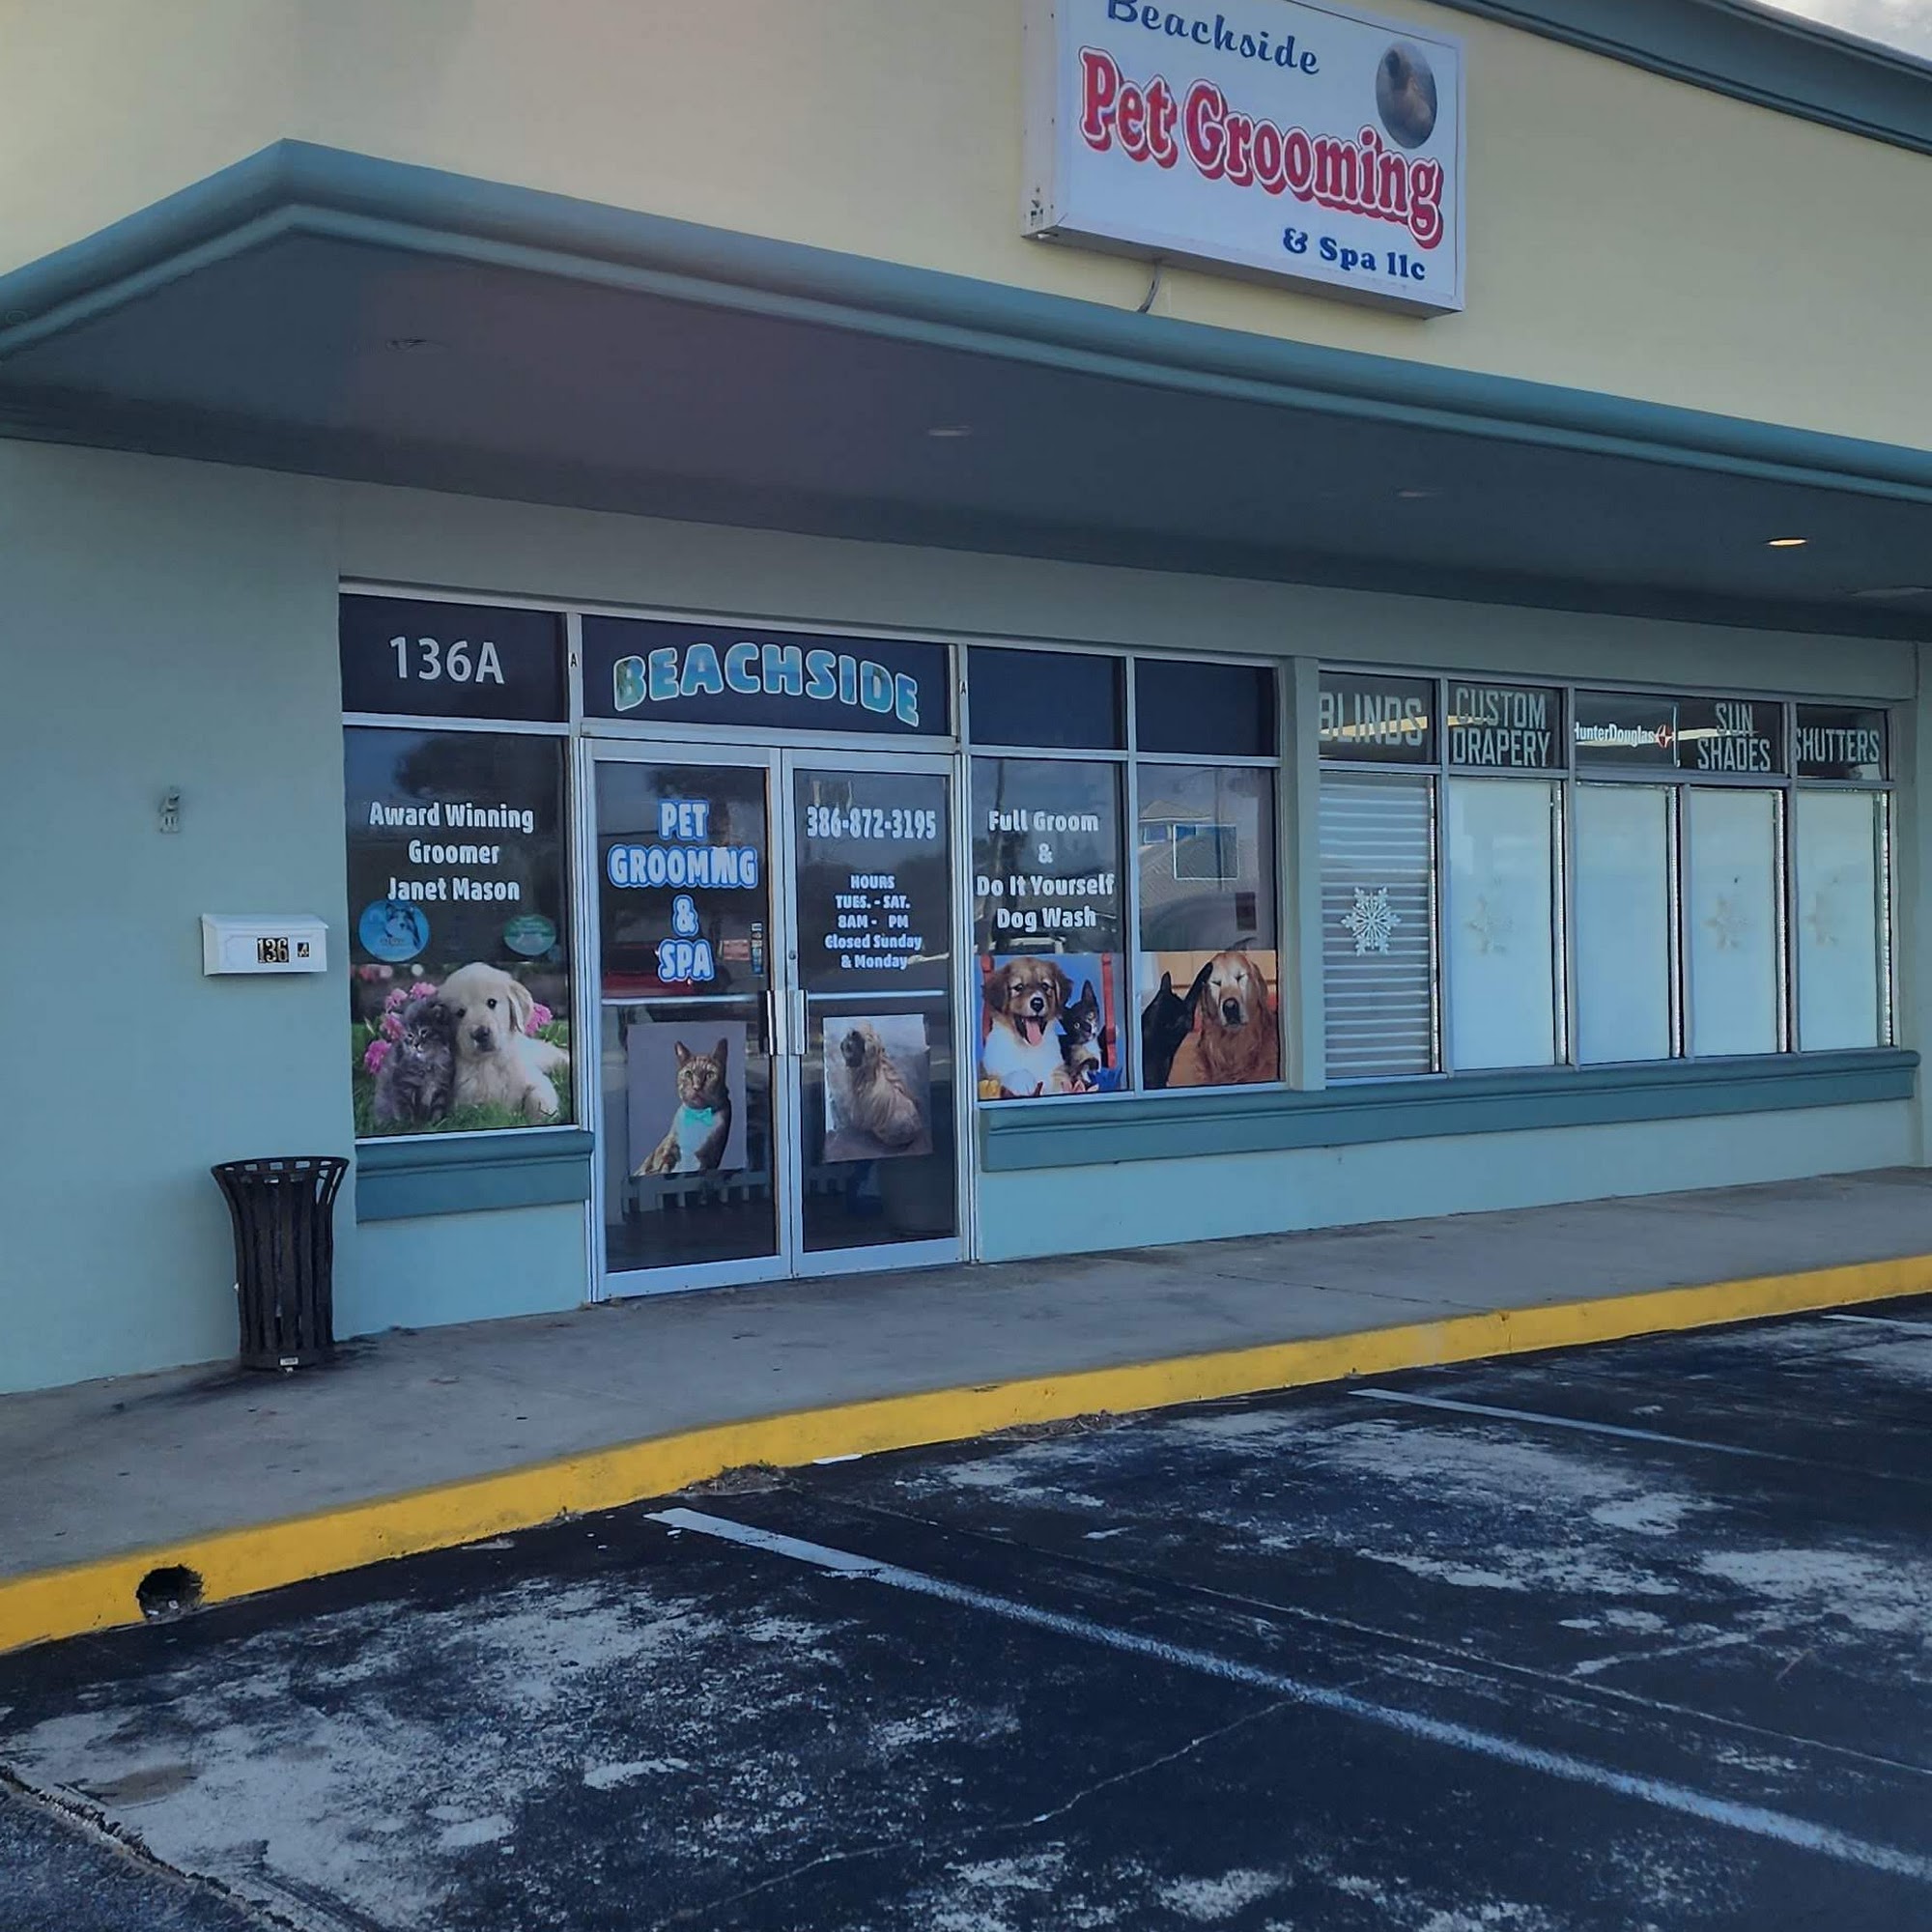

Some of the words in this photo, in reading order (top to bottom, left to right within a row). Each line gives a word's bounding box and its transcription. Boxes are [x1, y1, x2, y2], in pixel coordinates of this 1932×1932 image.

[1108, 0, 1320, 74] Beachside
[1079, 45, 1179, 168] Pet
[1182, 78, 1444, 249] Grooming
[1283, 227, 1308, 253] &
[1319, 238, 1376, 271] Spa
[390, 637, 504, 684] 136A
[613, 642, 919, 726] BEACHSIDE
[1319, 692, 1423, 746] BLINDS
[1456, 687, 1546, 729] CUSTOM
[1716, 702, 1753, 734] SUN
[1453, 727, 1551, 767] DRAPERY
[1697, 737, 1771, 772] SHADES
[369, 802, 440, 827] Award
[445, 803, 534, 834] Winning
[658, 799, 710, 840] PET
[807, 806, 937, 839] 386-872-3195
[988, 810, 1028, 832] Full
[1033, 810, 1099, 832] Groom
[409, 839, 500, 865] Groomer
[1037, 843, 1053, 864] &
[387, 877, 447, 900] Janet
[452, 877, 521, 900] Mason
[850, 874, 895, 889] HOURS
[977, 875, 1004, 896] Do
[1009, 875, 1025, 895] It
[1030, 874, 1115, 895] Yourself
[672, 895, 699, 937] &
[835, 895, 871, 909] TUES.
[883, 895, 911, 909] SAT.
[838, 914, 868, 928] 8AM
[888, 914, 909, 928] PM
[996, 908, 1037, 932] Dog
[1041, 906, 1097, 927] Wash
[258, 938, 289, 962] 136
[824, 934, 870, 949] Closed
[872, 933, 923, 951] Sunday
[658, 940, 714, 982] SPA
[840, 954, 852, 968] &
[854, 953, 908, 970] Monday
